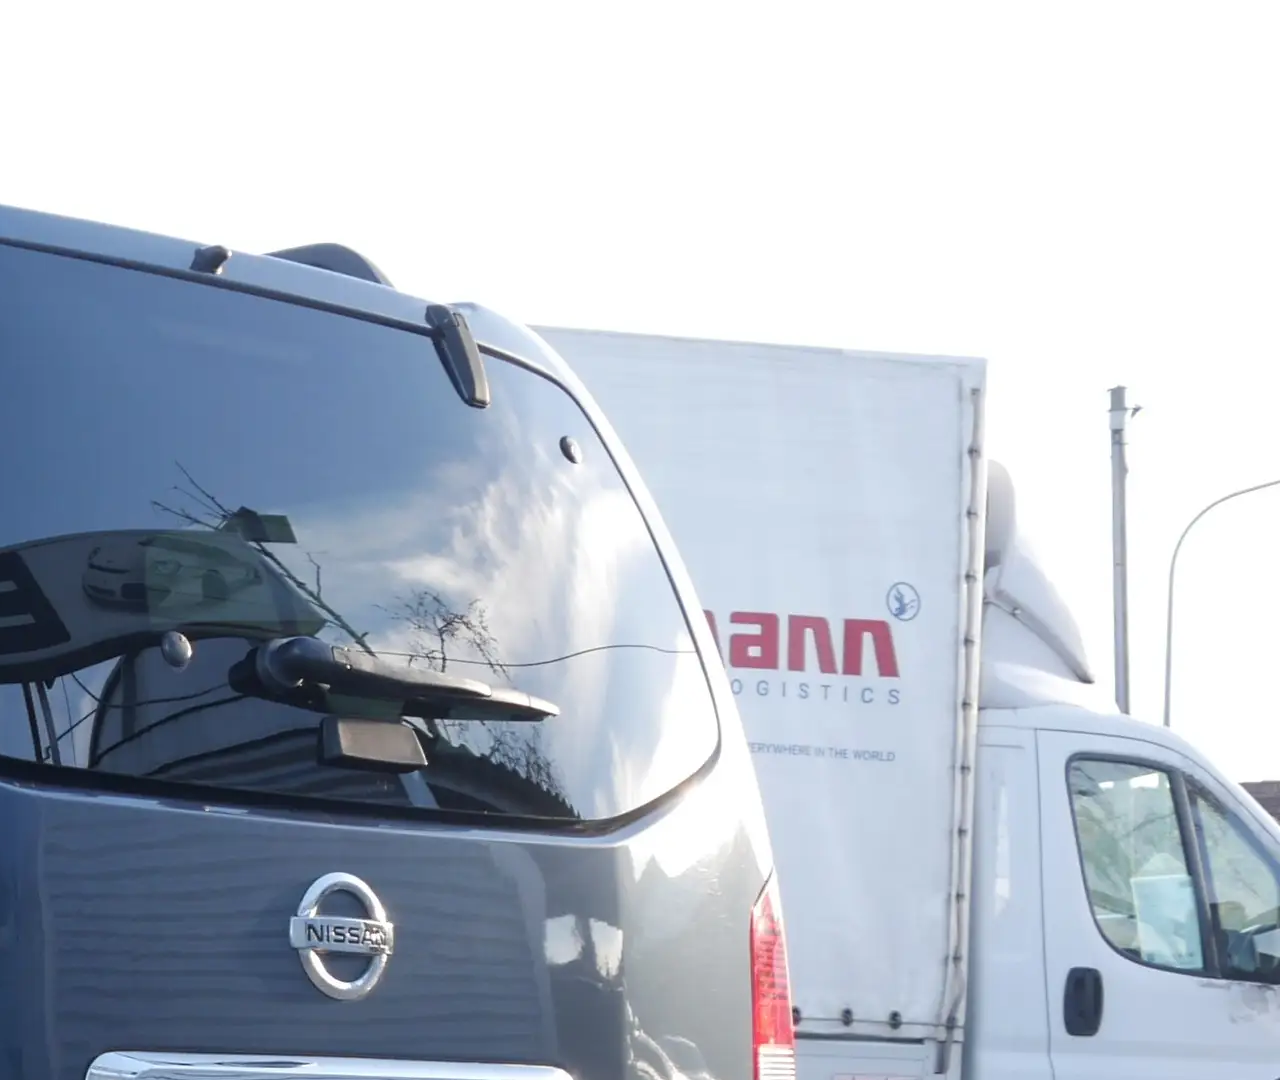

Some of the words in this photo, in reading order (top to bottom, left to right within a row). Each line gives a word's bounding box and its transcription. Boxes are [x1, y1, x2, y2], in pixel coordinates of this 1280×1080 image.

[703, 609, 901, 678] ann
[731, 679, 901, 705] OGISTICS
[747, 742, 812, 756] ERYWHERE
[814, 746, 825, 757] IN
[828, 747, 849, 759] THE
[853, 749, 896, 762] WORLD
[307, 924, 386, 945] NISSAN
